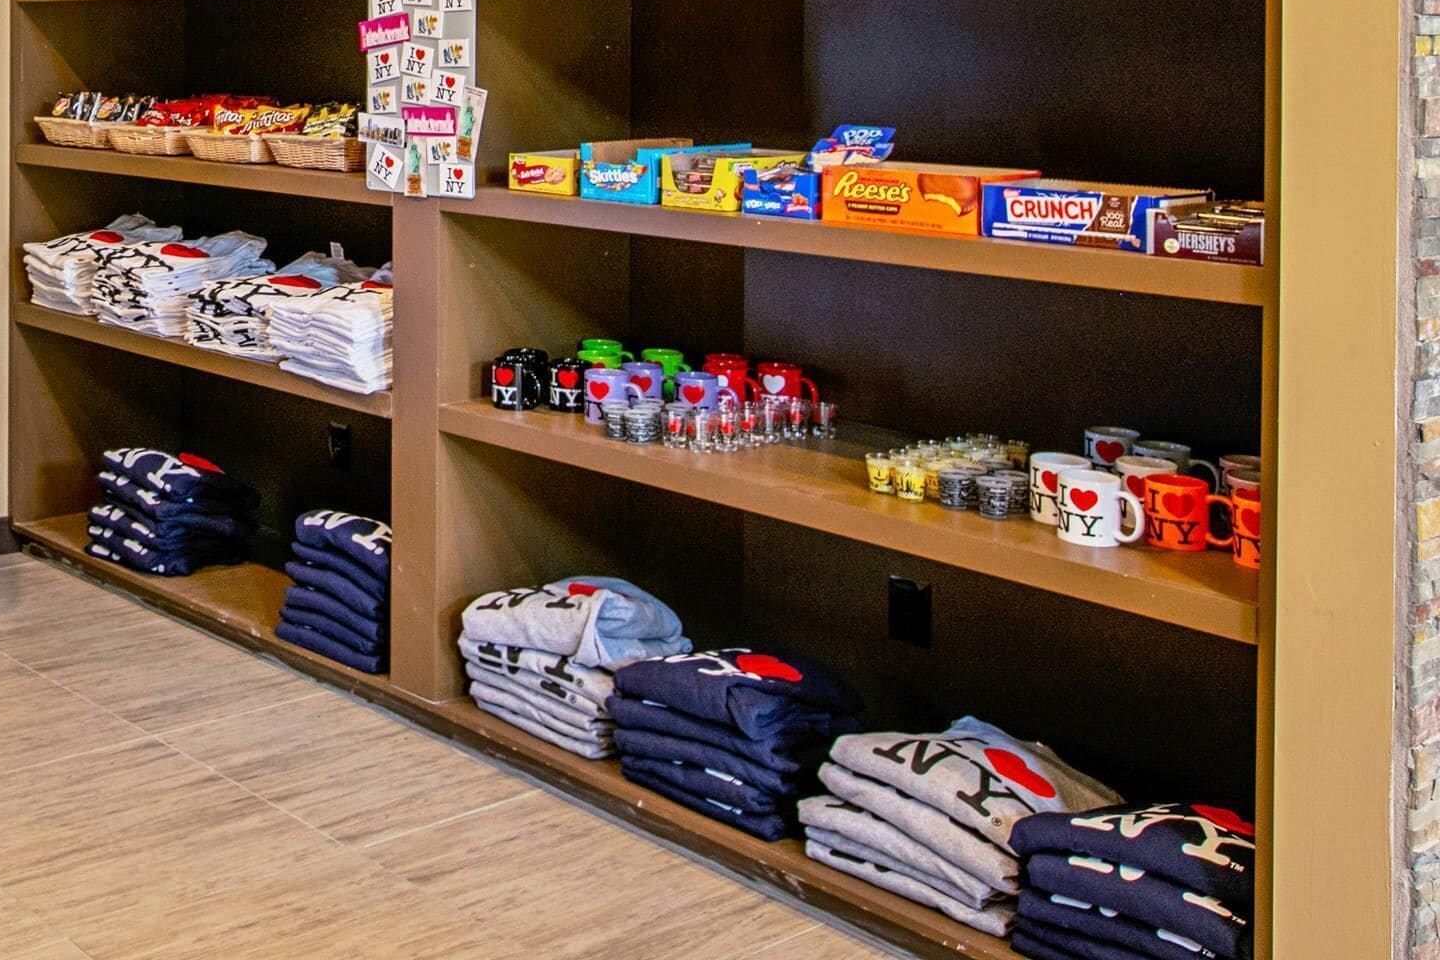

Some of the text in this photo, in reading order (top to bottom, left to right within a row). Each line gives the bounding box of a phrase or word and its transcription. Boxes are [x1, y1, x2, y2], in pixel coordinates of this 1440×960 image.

[378, 0, 396, 14] NY
[374, 55, 380, 66] I
[410, 47, 415, 58] I
[374, 64, 392, 80] NY
[406, 59, 426, 74] NY
[440, 74, 444, 86] I
[436, 86, 456, 102] NY
[379, 152, 386, 163] I
[374, 161, 392, 180] NY
[448, 168, 452, 180] I
[590, 168, 638, 184] Skittles
[446, 180, 465, 194] NY
[833, 171, 912, 203] Reese's
[1010, 200, 1093, 220] CRUNCH
[1100, 216, 1126, 228] Real
[1178, 232, 1236, 254] HERSHEY'S
[550, 368, 558, 386] I
[550, 387, 582, 407] NY
[1087, 437, 1094, 460] I
[104, 447, 201, 488] NY
[1032, 466, 1039, 488] I
[1060, 483, 1068, 507] I
[1148, 488, 1160, 514] I
[1058, 506, 1104, 537] NY
[1146, 514, 1200, 544] NY
[872, 737, 1039, 818] NY
[1070, 805, 1256, 867] NY
